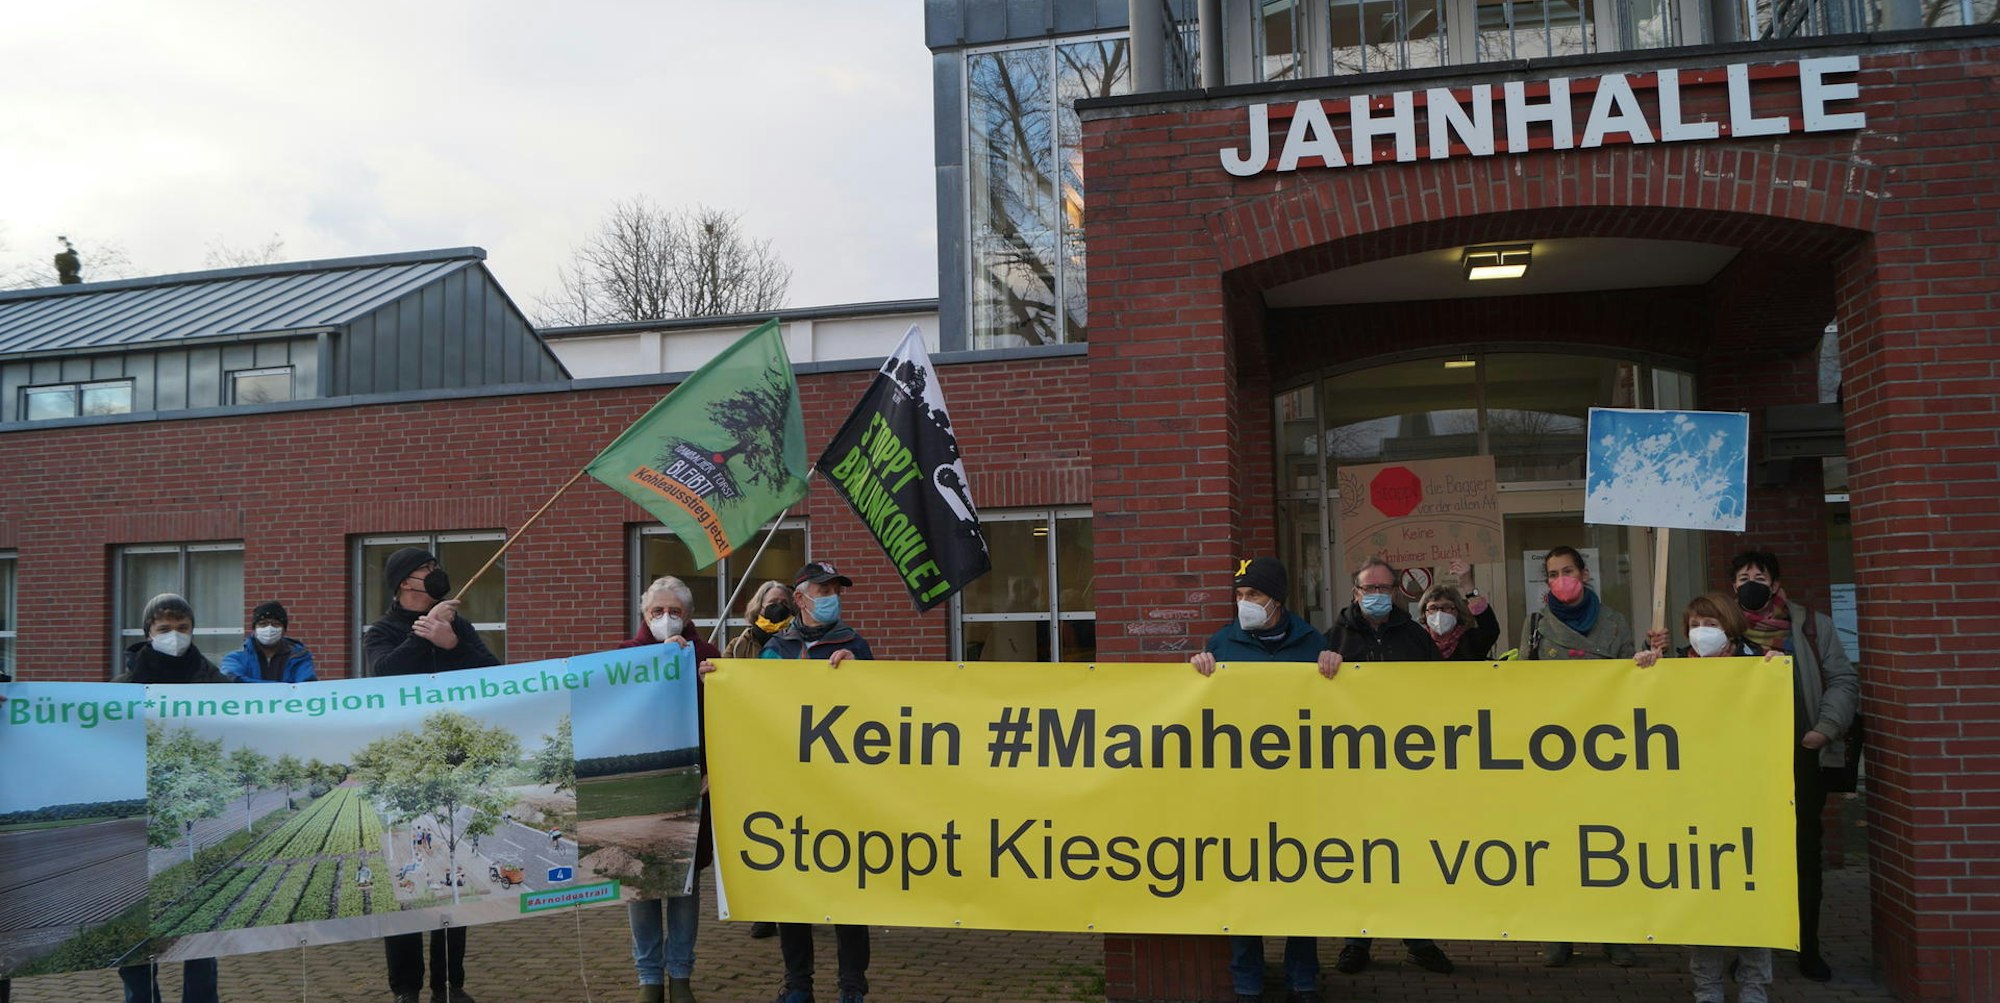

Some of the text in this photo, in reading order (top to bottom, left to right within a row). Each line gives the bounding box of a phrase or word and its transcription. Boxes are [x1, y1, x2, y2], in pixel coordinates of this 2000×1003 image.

[1220, 55, 1866, 178] JAHNHALLE
[861, 411, 924, 494] STOPPT
[634, 467, 729, 553] Kohleausstieg jetzt!
[713, 472, 735, 498] FORST
[1417, 496, 1497, 514] vor der alten A4
[1425, 478, 1442, 495] die
[1445, 474, 1493, 497] Bagger
[831, 445, 951, 603] BRAUNKOHLE!
[1402, 527, 1435, 540] Keine
[399, 668, 595, 707] Hambacher
[603, 655, 681, 686] Wald
[799, 704, 1680, 772] Kein #ManheimerLoch
[740, 811, 1756, 899] Stoppt Kiesgruben vor Buir!
[527, 887, 608, 907] #Arnoldustrail
